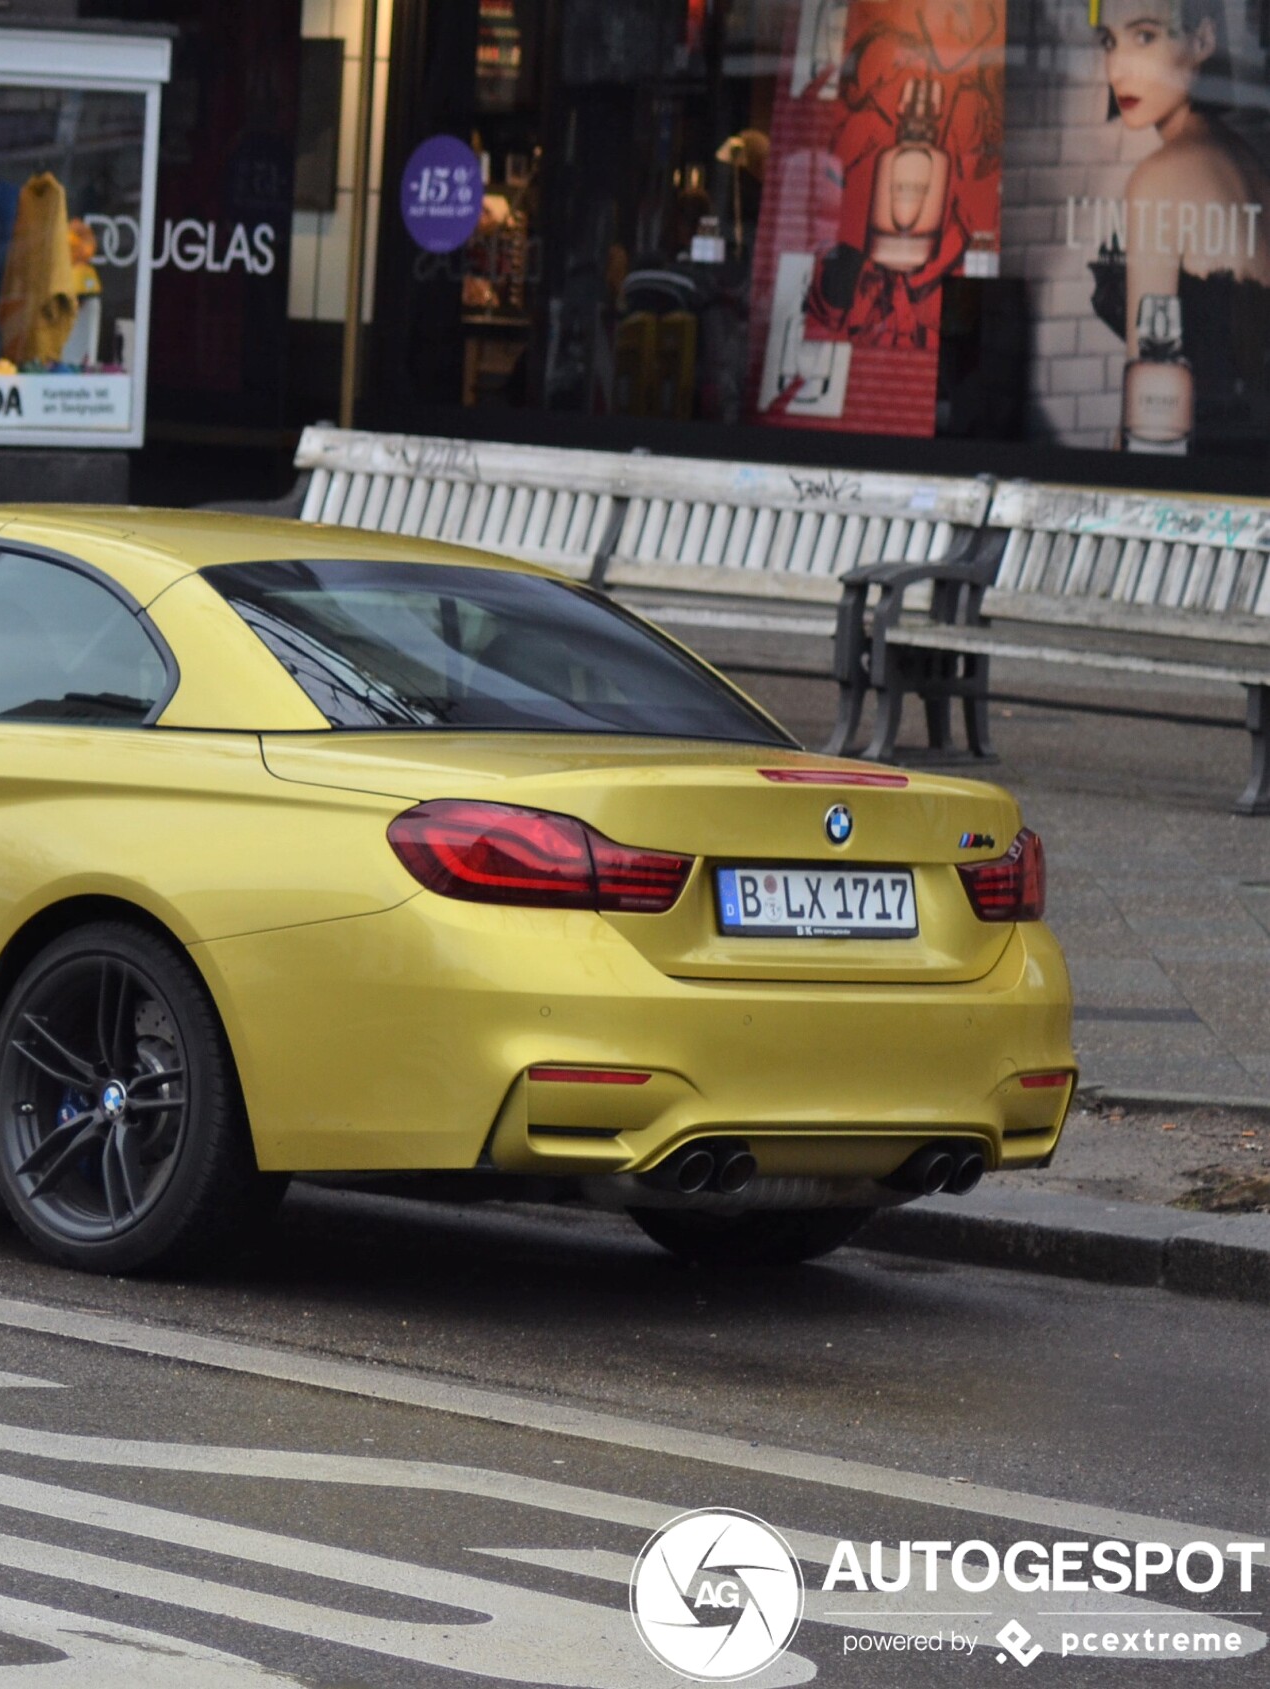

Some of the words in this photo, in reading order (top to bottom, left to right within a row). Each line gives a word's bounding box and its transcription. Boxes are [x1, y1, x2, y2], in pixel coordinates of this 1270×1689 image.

[84, 214, 275, 276] DOUGLAS
[1066, 196, 1262, 258] L'INTERDIT
[726, 903, 735, 916] D
[740, 875, 762, 918] B
[783, 876, 826, 919] LX
[833, 876, 908, 920] 1717
